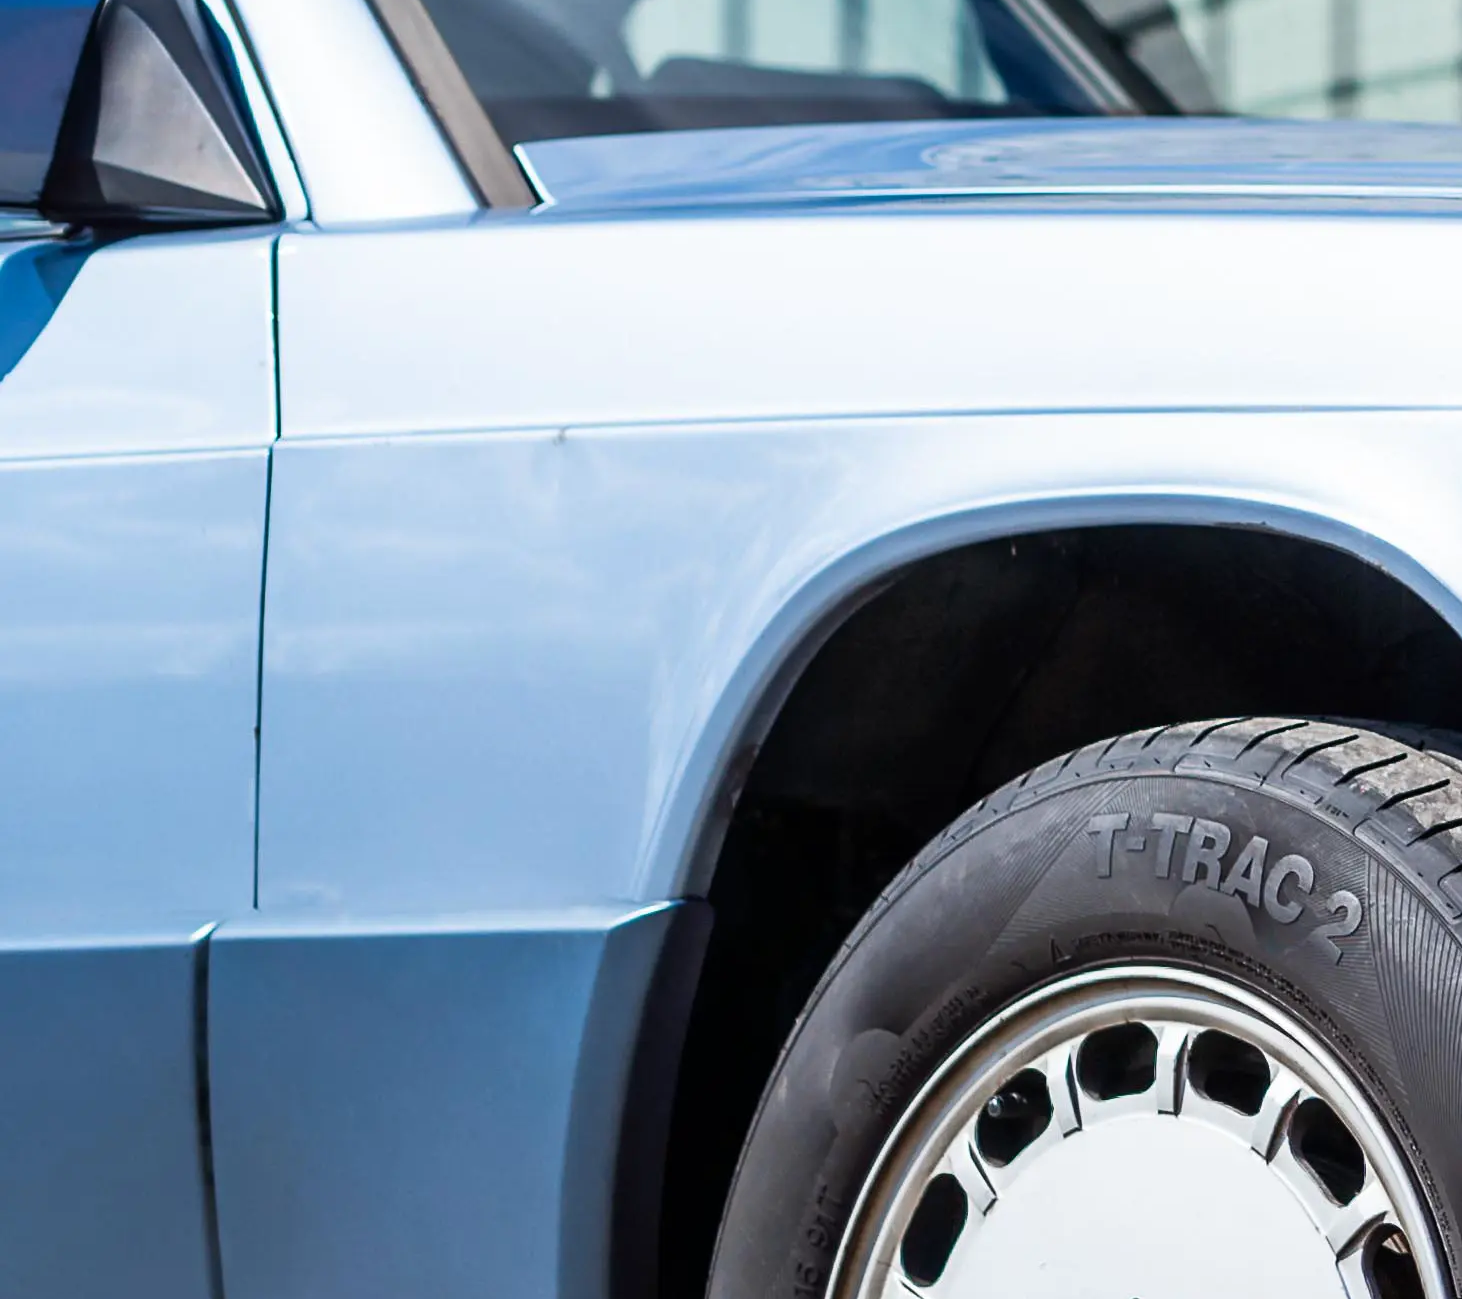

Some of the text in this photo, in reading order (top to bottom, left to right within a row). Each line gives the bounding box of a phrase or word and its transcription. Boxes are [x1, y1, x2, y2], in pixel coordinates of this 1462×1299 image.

[1088, 812, 1314, 924] T-TRAC
[1304, 890, 1363, 966] 2
[805, 1184, 843, 1249] 91T
[793, 1260, 824, 1299] 15
